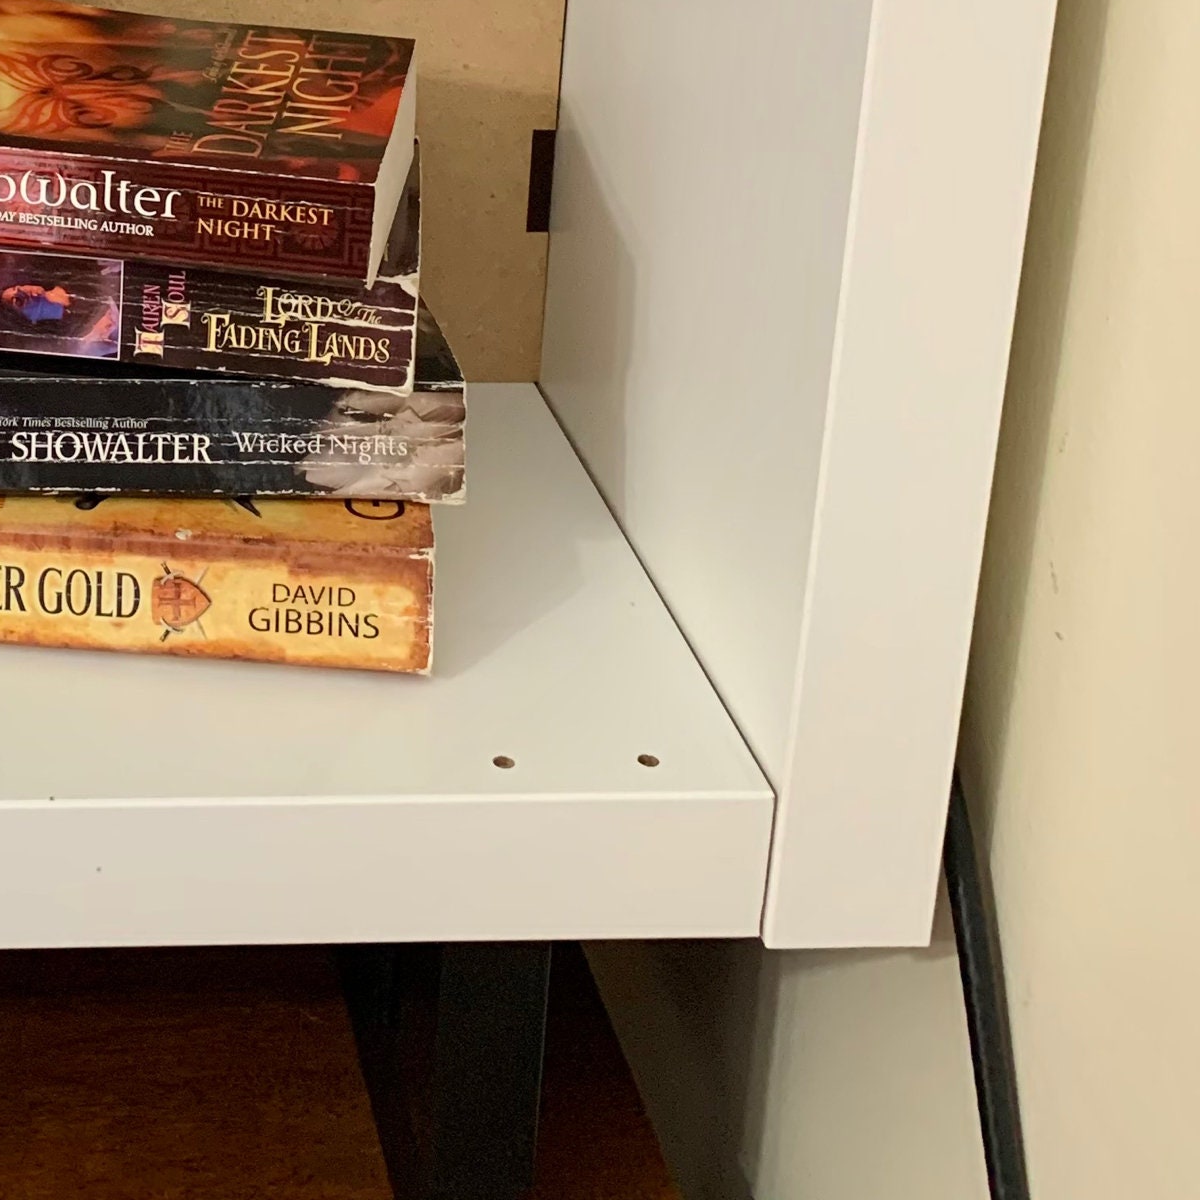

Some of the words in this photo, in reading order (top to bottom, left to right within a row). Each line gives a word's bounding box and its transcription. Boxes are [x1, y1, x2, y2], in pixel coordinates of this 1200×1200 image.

[191, 29, 307, 159] DARKEST
[277, 33, 372, 140] NIGHT
[163, 131, 194, 153] THE
[18, 211, 99, 232] BESTSELLING
[100, 220, 155, 238] AUTHOR
[197, 194, 225, 211] THE
[231, 199, 334, 227] DARKEST
[197, 216, 277, 242] NIGHT
[159, 270, 192, 330] SOUL
[256, 285, 334, 328] LORD
[133, 283, 166, 360] TAIREN
[200, 312, 303, 353] FADING
[302, 321, 392, 366] LANDS
[21, 417, 51, 428] Times
[54, 417, 109, 430] Bestselling
[111, 417, 148, 429] Author
[11, 431, 213, 464] SHOWALTER
[233, 432, 322, 456] Wicked
[330, 433, 409, 465] Nights
[38, 567, 141, 619] GOLD
[272, 583, 356, 608] DAVID
[249, 607, 381, 639] GIBBINS
